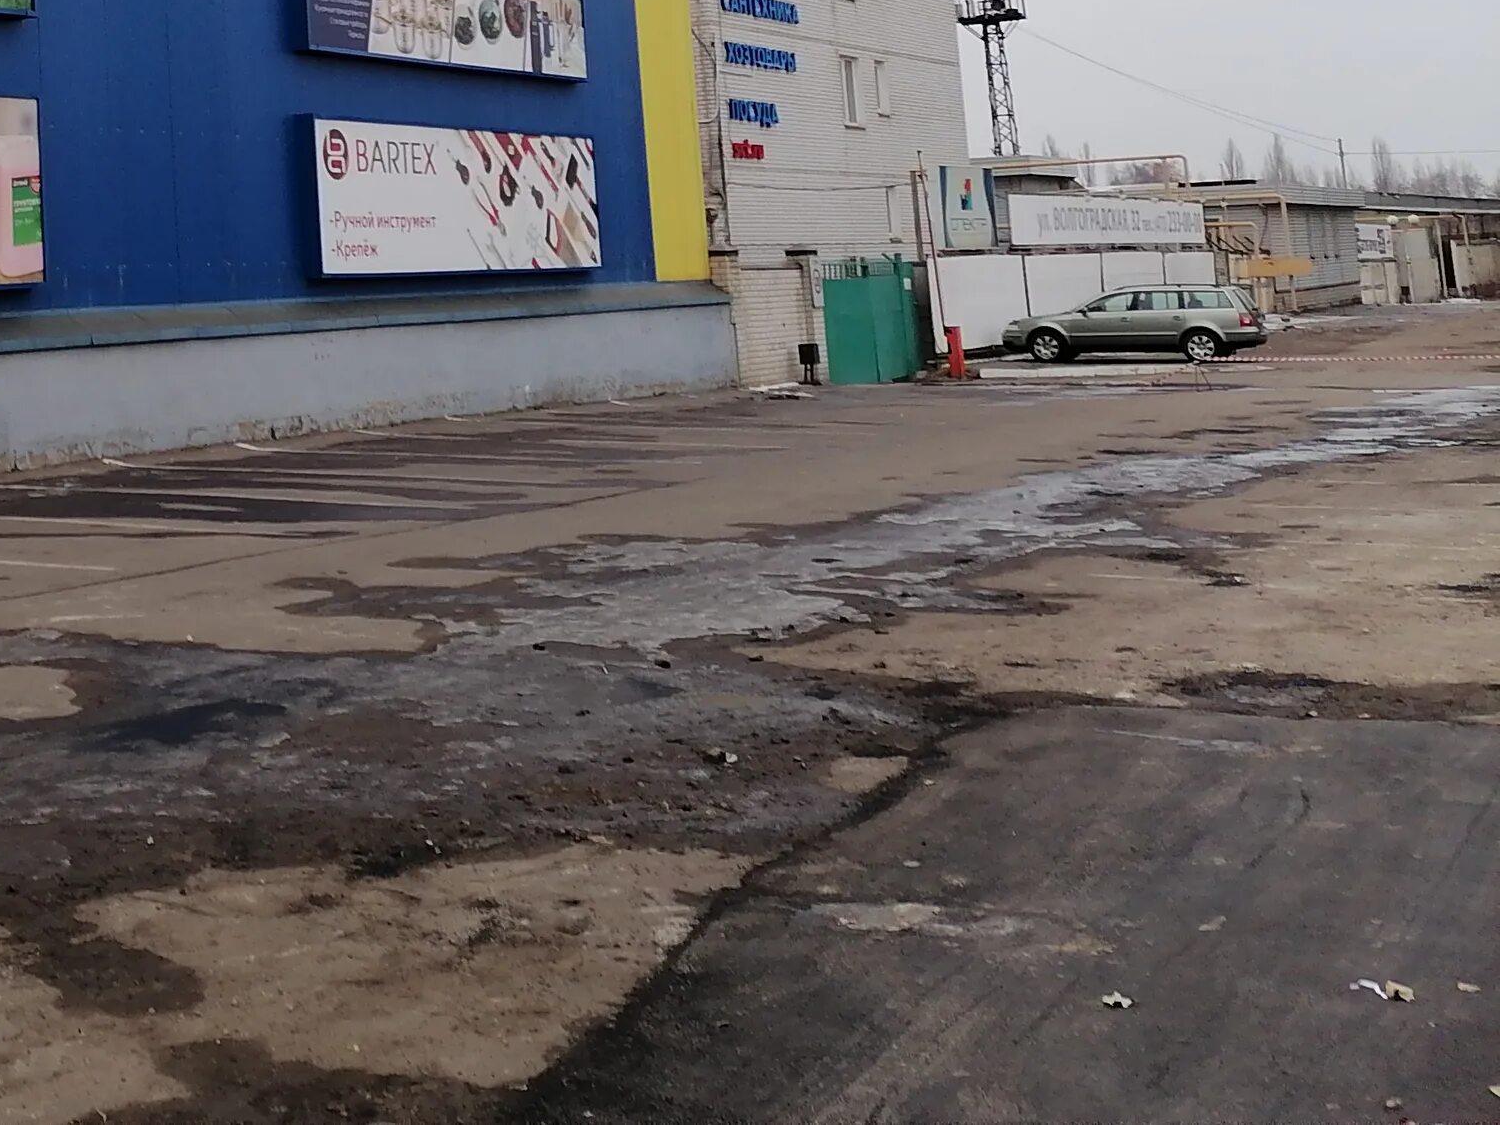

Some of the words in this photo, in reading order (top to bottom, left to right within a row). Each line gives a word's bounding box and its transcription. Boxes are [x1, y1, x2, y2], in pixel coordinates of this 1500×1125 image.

[724, 41, 796, 73] ХОЗТОВАРЫ
[356, 139, 437, 175] BARTEX
[376, 214, 437, 233] инструмент
